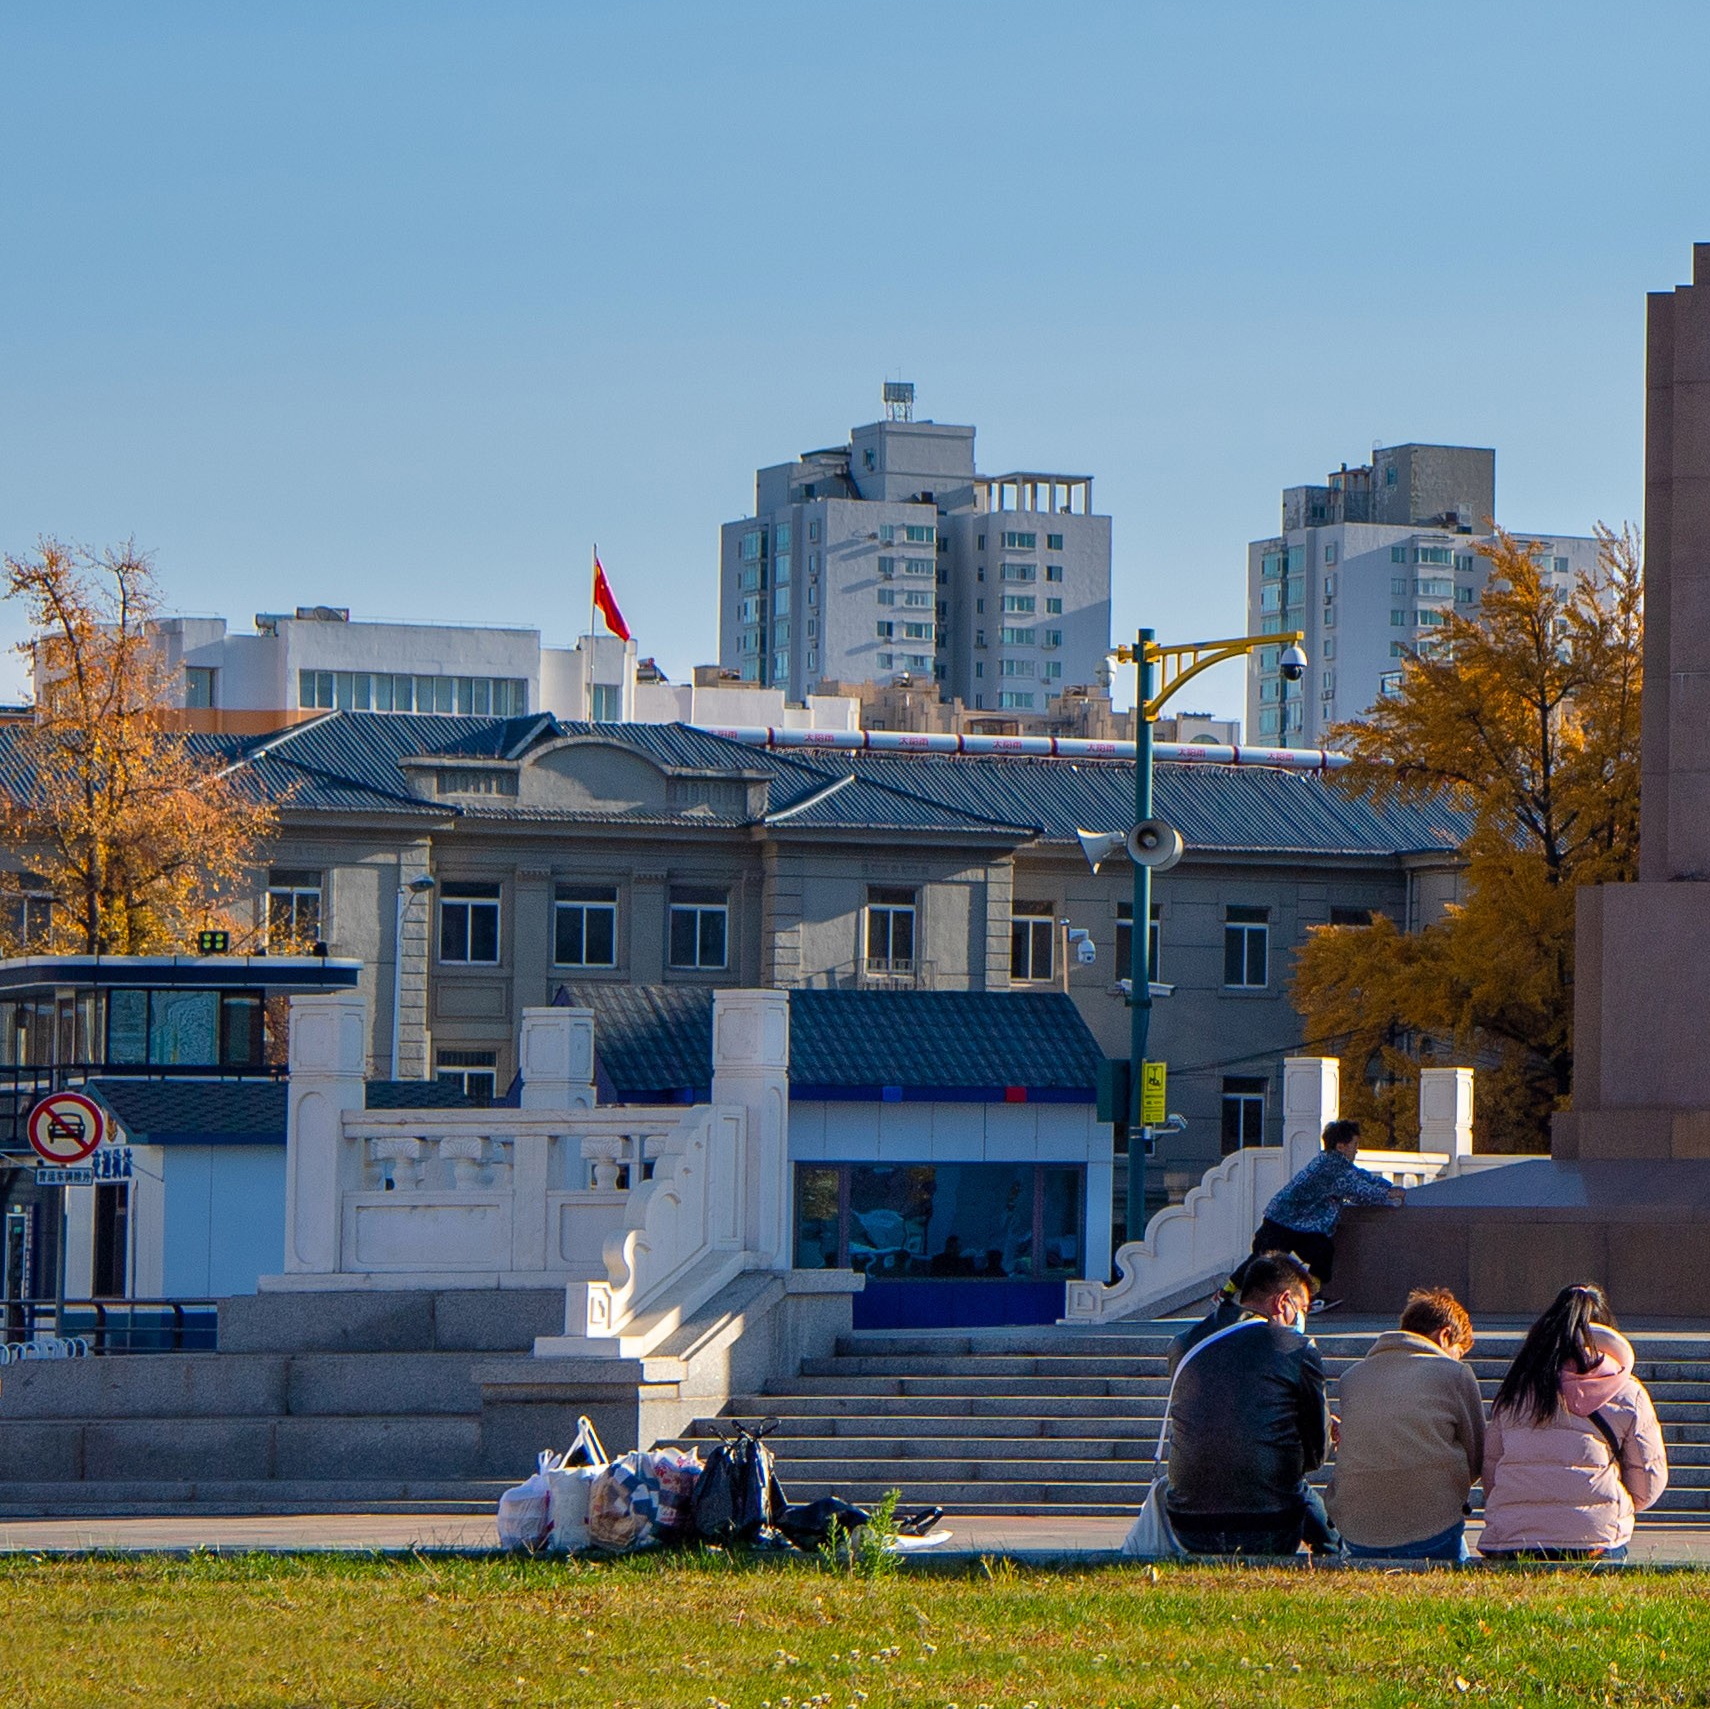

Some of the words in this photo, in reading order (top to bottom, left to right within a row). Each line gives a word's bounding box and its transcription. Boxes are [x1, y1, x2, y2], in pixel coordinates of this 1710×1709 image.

[804, 733, 834, 743] 太阳雨
[898, 736, 929, 746] 太阳雨
[992, 740, 1023, 750] 太阳雨
[1086, 743, 1116, 754] 太阳雨
[1177, 747, 1206, 758] 太阳雨
[1266, 752, 1295, 762] 太阳雨
